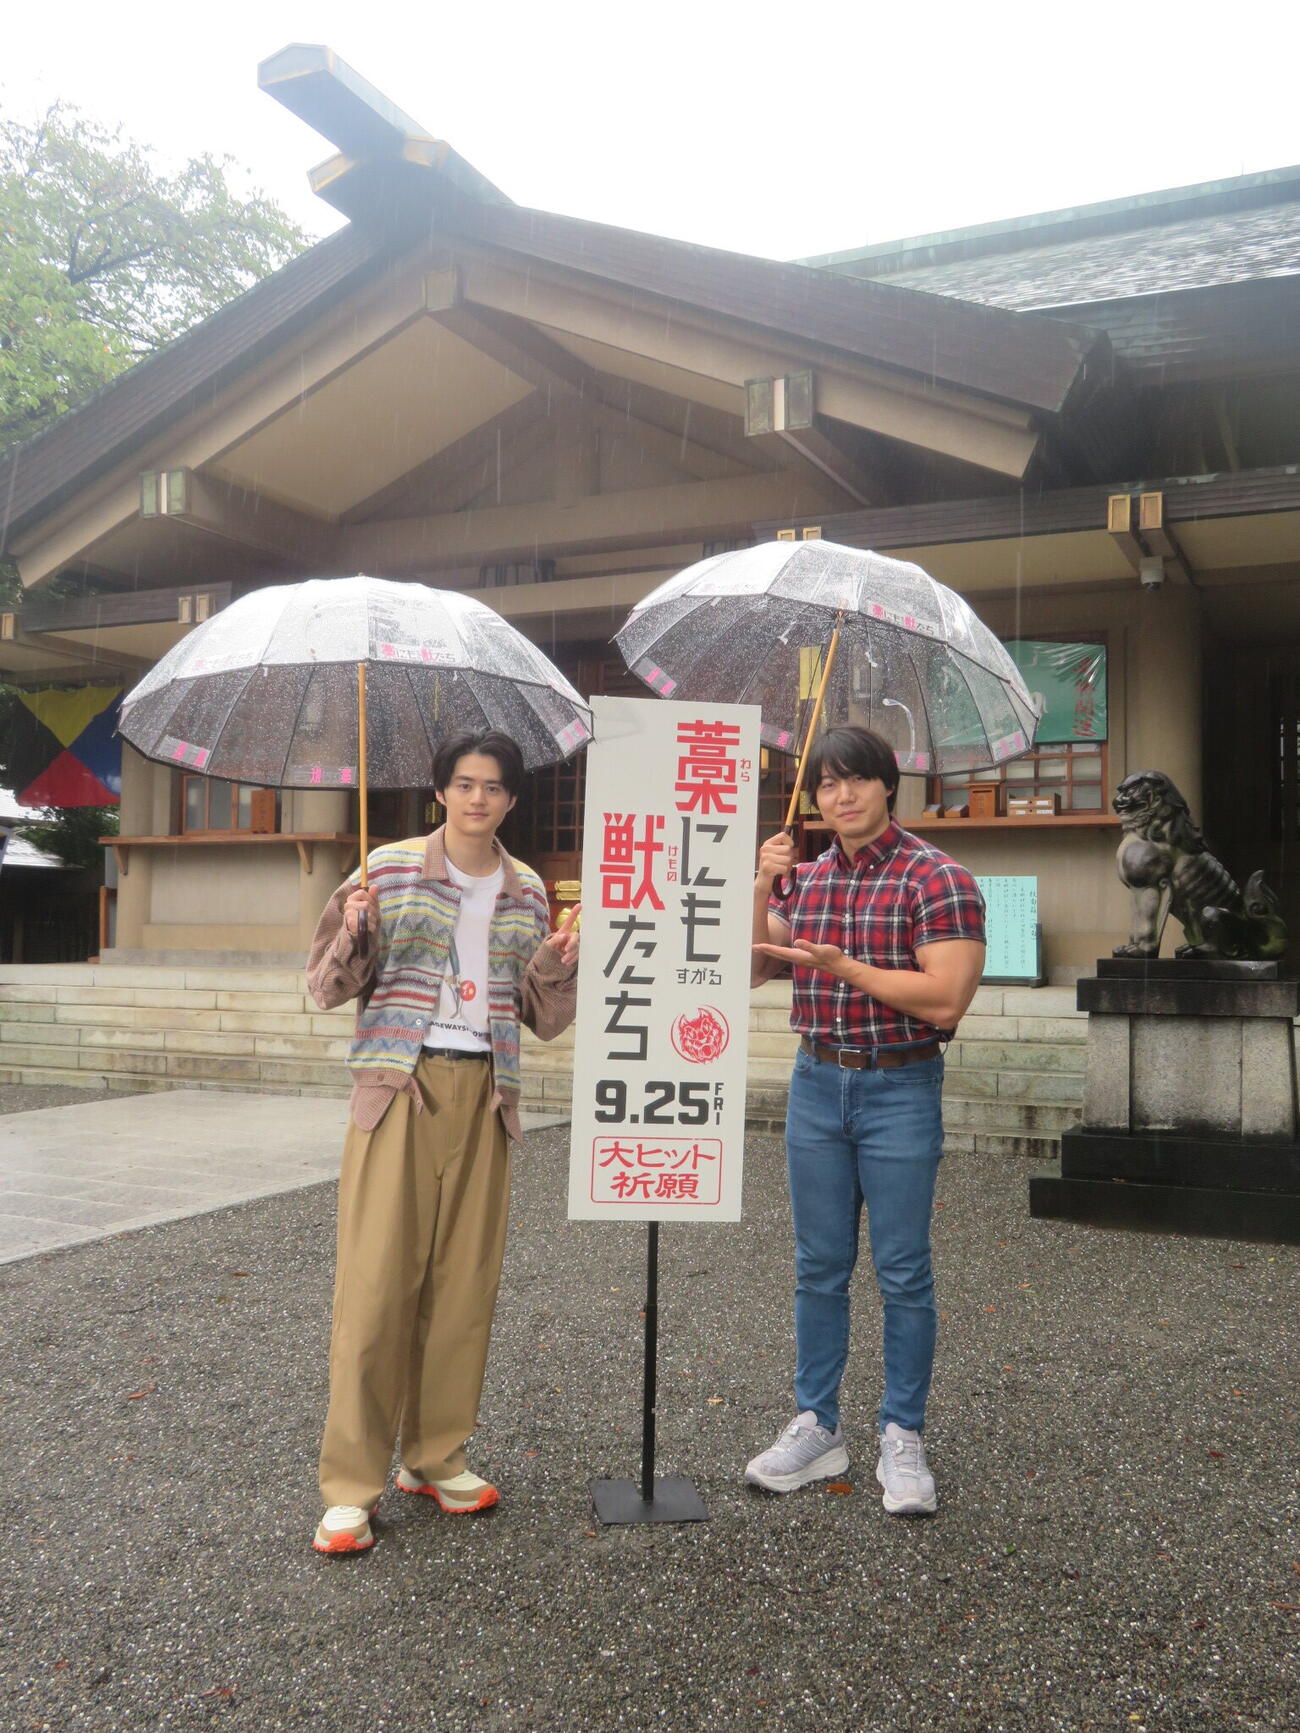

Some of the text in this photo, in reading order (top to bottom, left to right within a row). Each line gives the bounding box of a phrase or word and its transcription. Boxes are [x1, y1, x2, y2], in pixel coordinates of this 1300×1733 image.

[740, 758, 752, 782] わら
[667, 846, 678, 882] けもの
[599, 812, 666, 1061] 獣たち
[676, 968, 722, 986] すがる
[594, 1079, 710, 1126] 9.25
[713, 1082, 725, 1126] FRI
[599, 1141, 716, 1170] 大ヒット
[610, 1171, 699, 1200] 祈願
